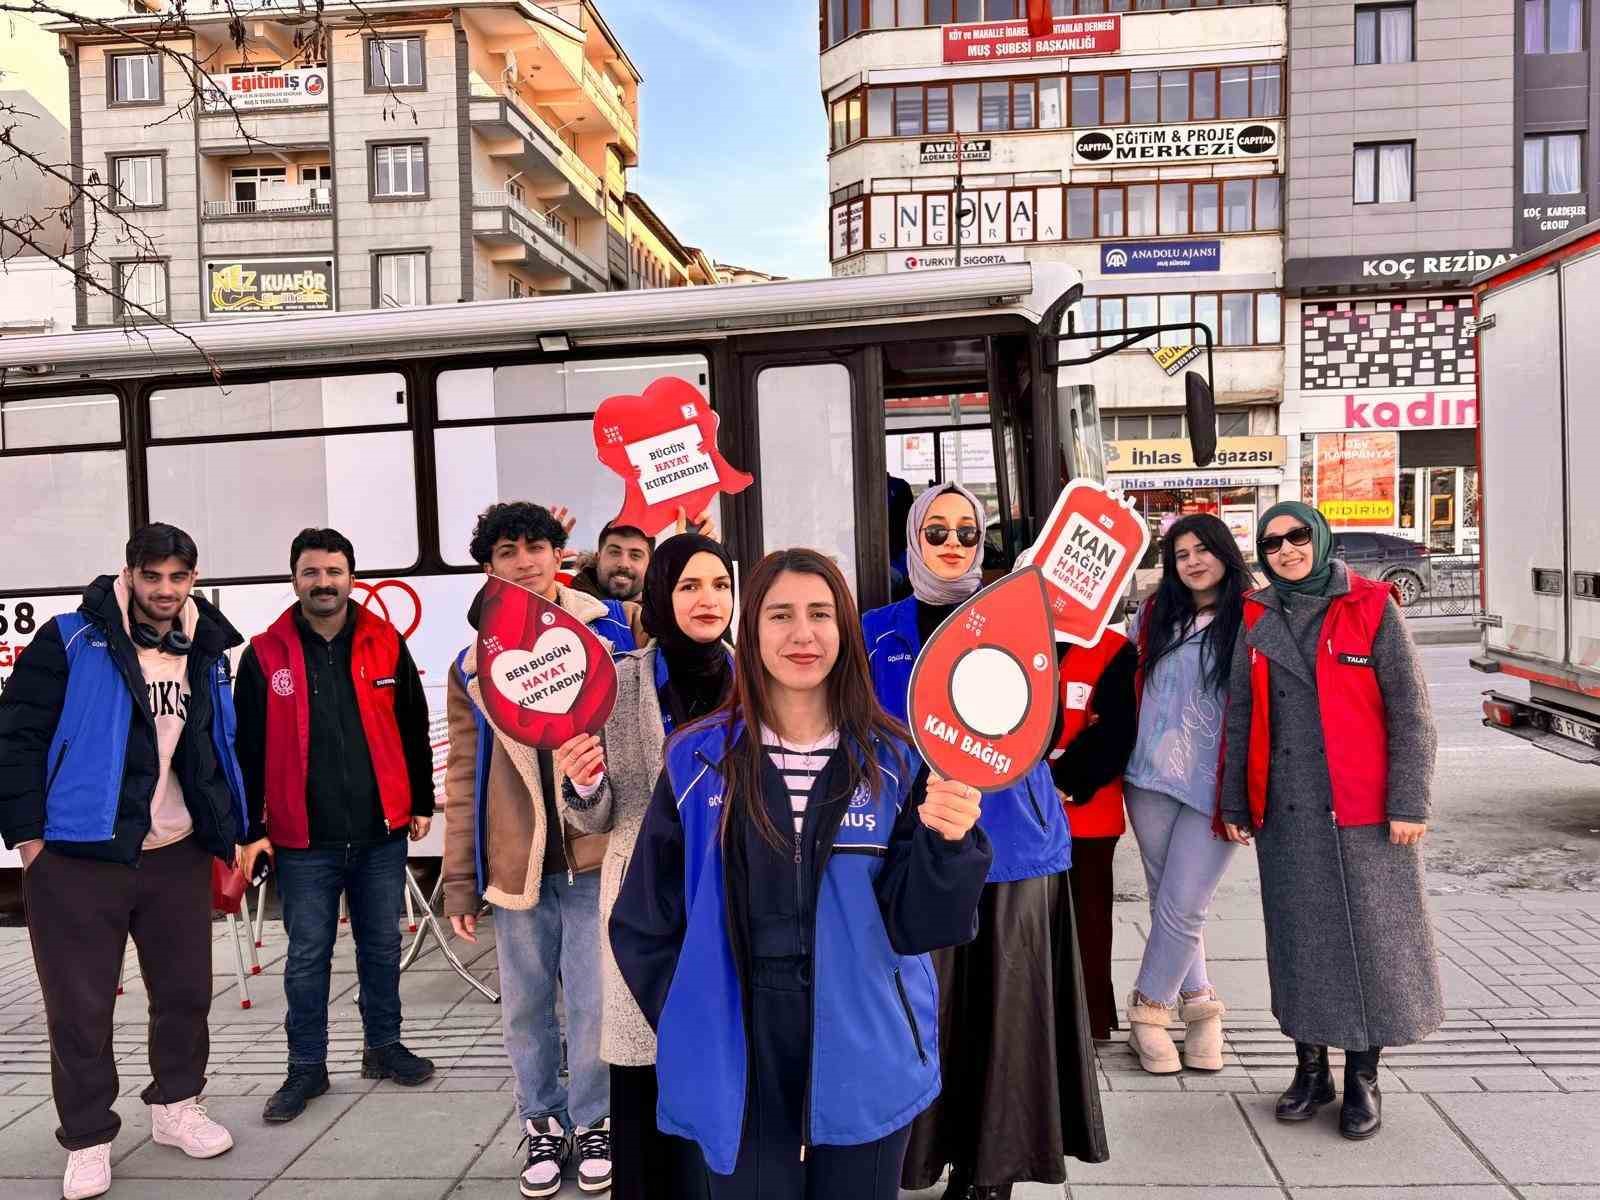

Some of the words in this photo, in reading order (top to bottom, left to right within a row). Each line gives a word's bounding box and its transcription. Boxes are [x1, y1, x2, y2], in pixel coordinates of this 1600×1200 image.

[973, 27, 1004, 40] MAHALLE
[1006, 25, 1029, 37] İDAREL
[967, 43, 991, 58] MUŞ
[995, 39, 1032, 56] ŞUBESİ
[1036, 36, 1096, 53] BAŞKANLIĞI
[1116, 129, 1166, 145] EĞİTİM
[1171, 130, 1181, 142] &
[1187, 127, 1235, 142] PROJE
[1238, 135, 1275, 146] CAPITAL
[925, 142, 986, 153] AVUKAT
[1077, 143, 1112, 152] CAPITAL
[1116, 142, 1235, 159] MERKEZİ
[899, 197, 1031, 229] NEOVA
[1523, 207, 1541, 220] KOÇ
[1546, 205, 1587, 218] KARDEŞLER
[878, 226, 1055, 244] SİGORTA
[1540, 220, 1569, 231] GROUP
[1131, 249, 1180, 259] ANADOLU
[1182, 247, 1217, 258] AJANSI
[1362, 258, 1416, 280] KOÇ
[261, 269, 328, 292] KUAFÖR
[654, 454, 690, 473] HAYAT
[1131, 447, 1182, 465] İhlas
[644, 462, 709, 491] KURTARDIM
[1163, 476, 1232, 488] mağazası
[1070, 523, 1117, 568] KAN
[1063, 543, 1106, 580] BAĞIŞI
[1052, 567, 1093, 601] KURTARIR
[1056, 556, 1100, 592] HAYAT
[505, 664, 530, 682] BEN
[530, 644, 572, 670] BUGÜN
[521, 662, 568, 692] HAYAT
[518, 669, 587, 708] KURTARDIM
[923, 713, 959, 745] KAN
[960, 735, 1014, 775] BAĞIŞI
[839, 812, 877, 832] MUŞ
